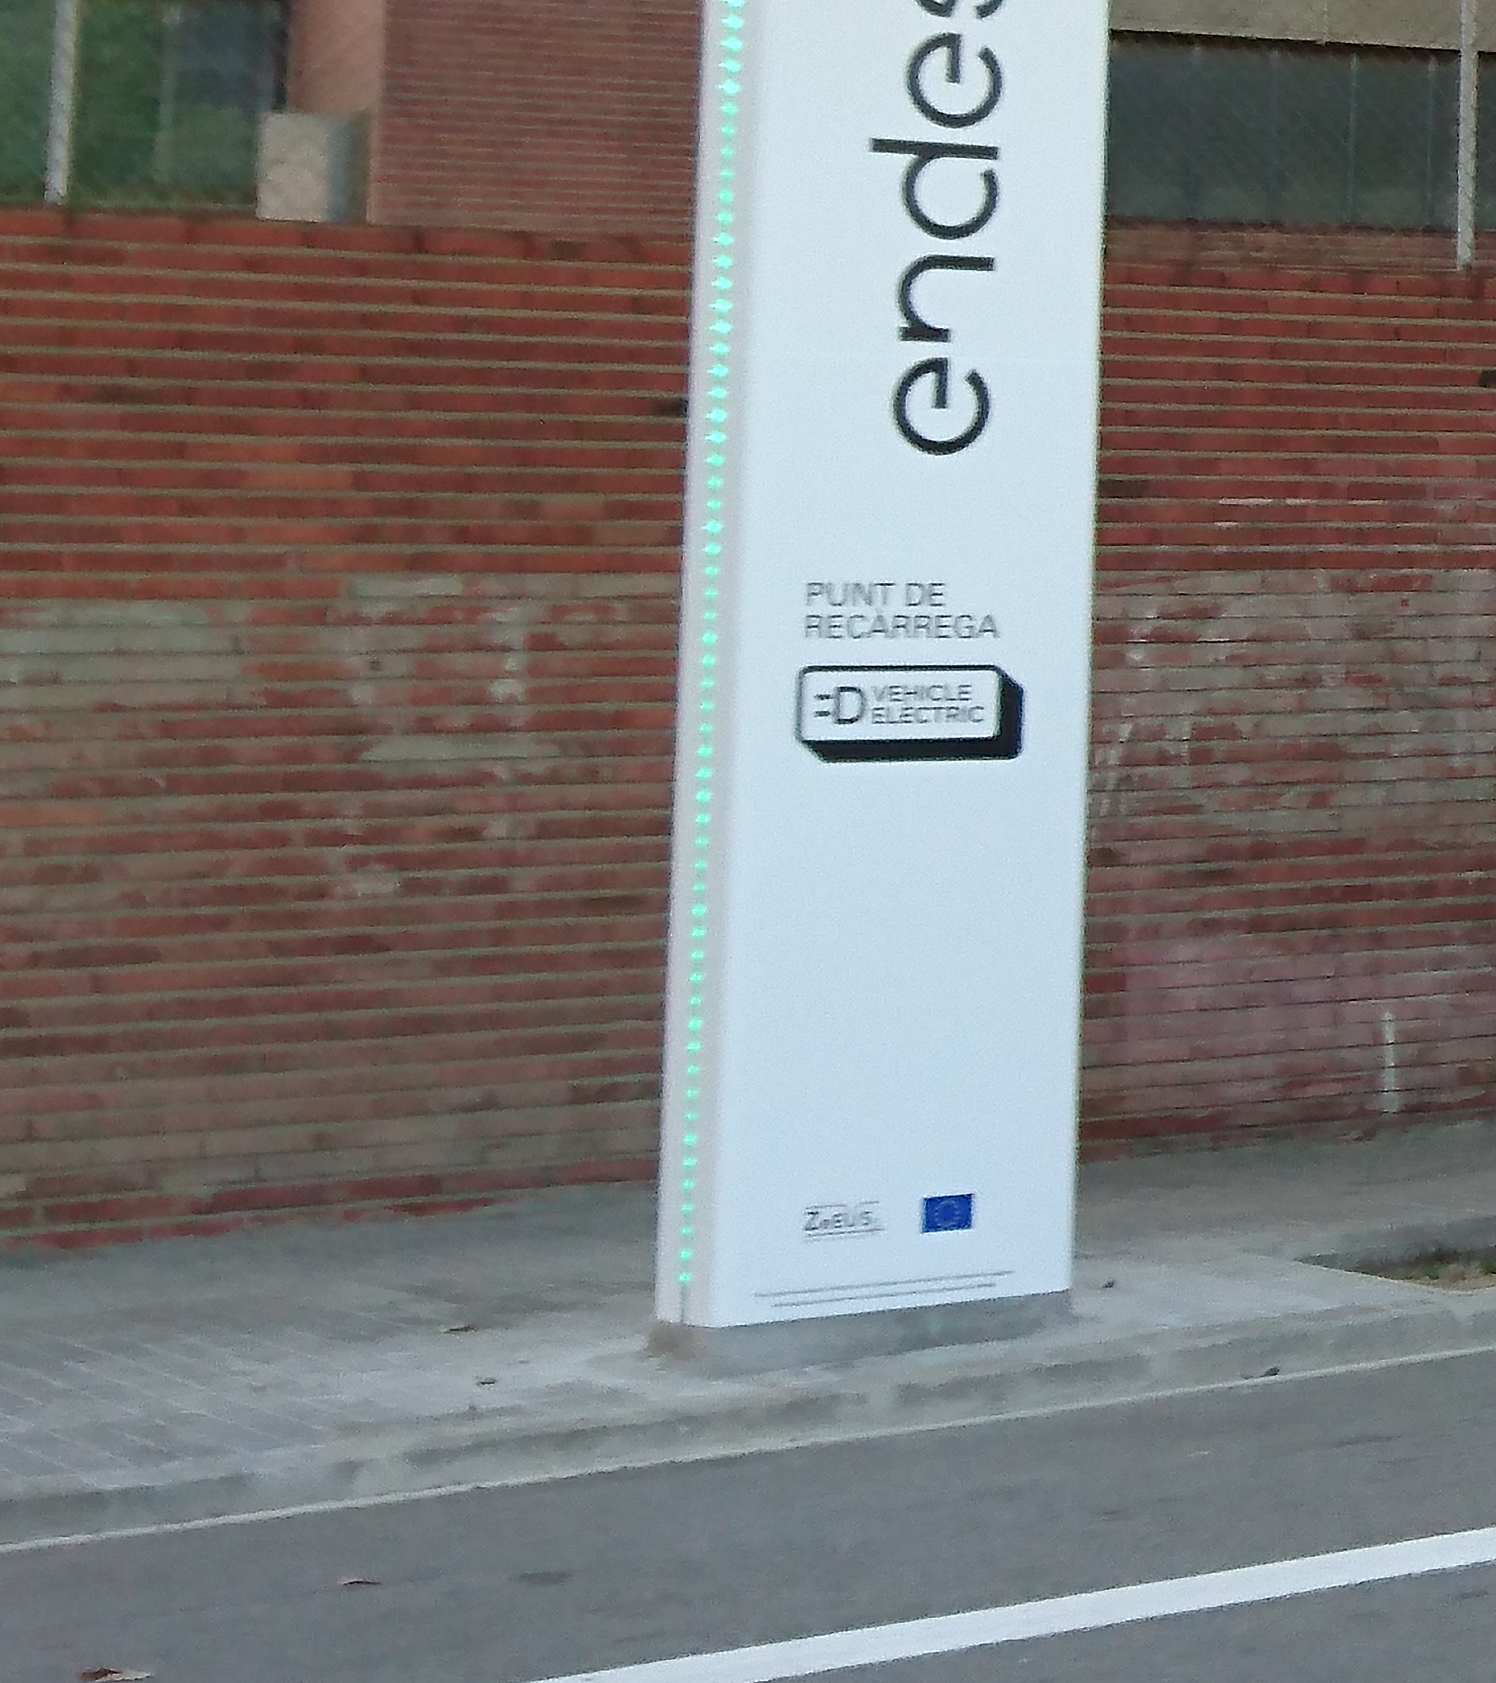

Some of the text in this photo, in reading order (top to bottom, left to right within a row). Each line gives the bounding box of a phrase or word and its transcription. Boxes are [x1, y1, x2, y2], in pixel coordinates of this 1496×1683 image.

[806, 582, 946, 607] PUNT DE
[872, 685, 972, 702] VEHICLE
